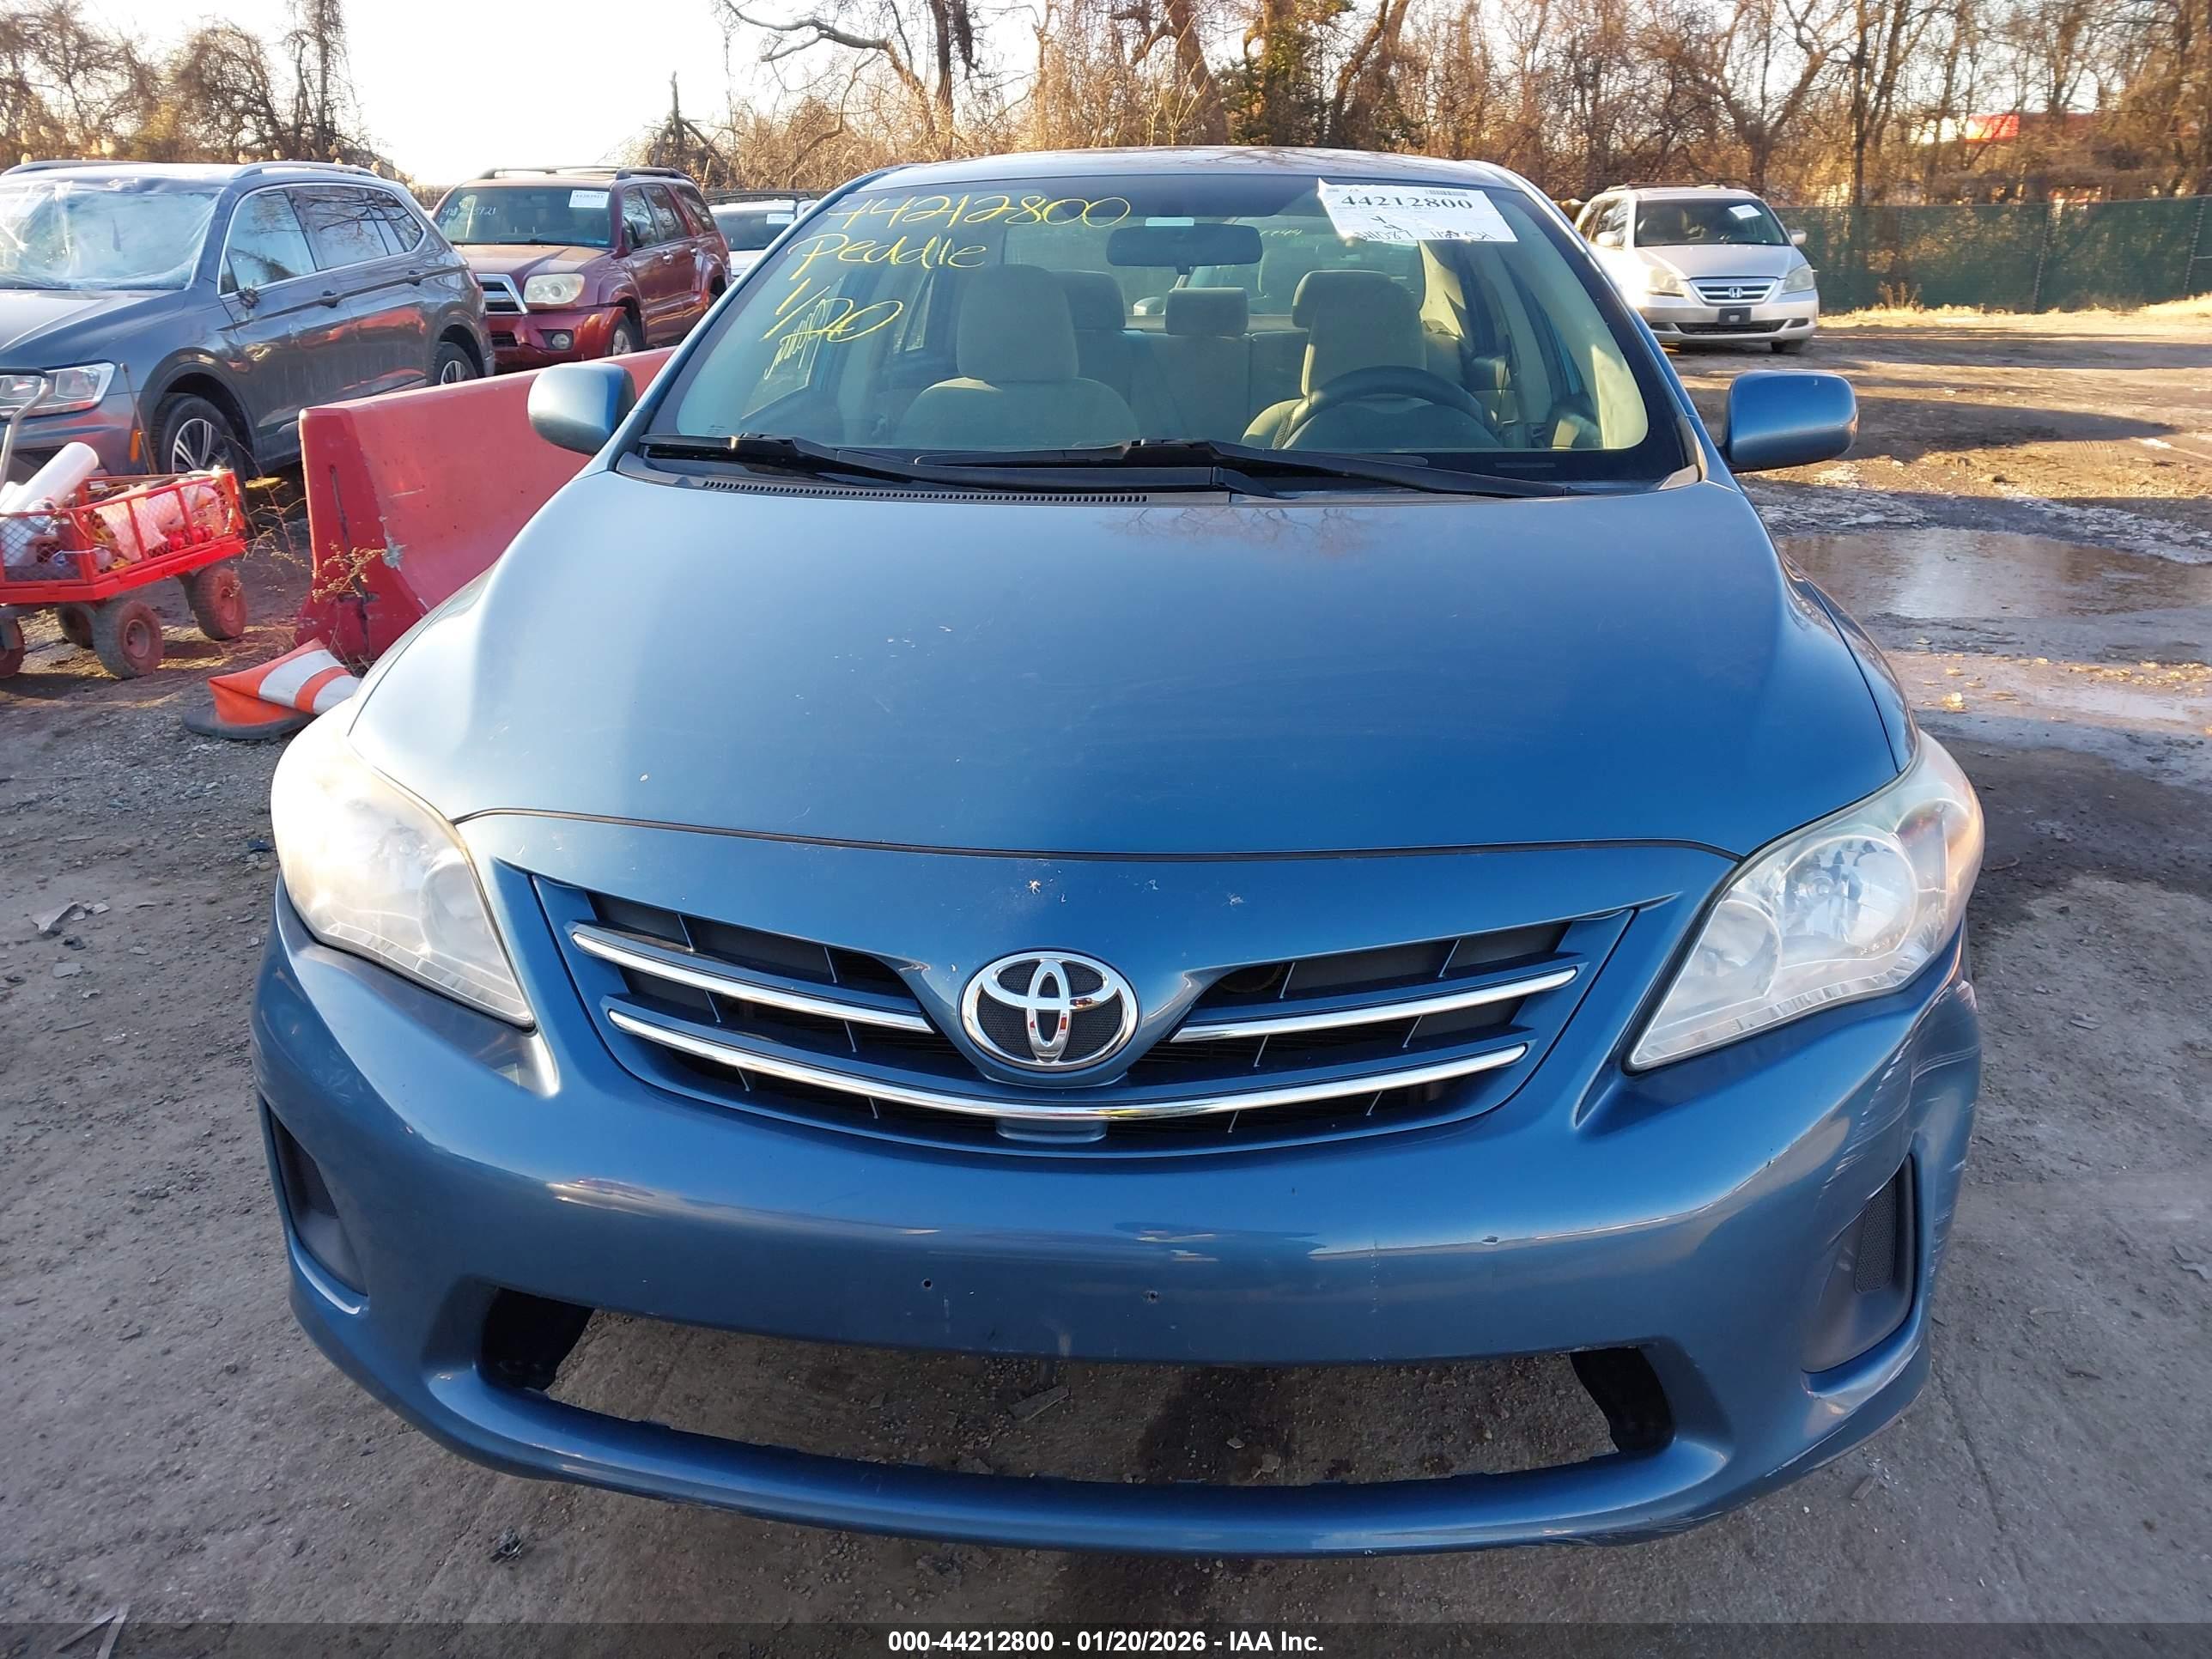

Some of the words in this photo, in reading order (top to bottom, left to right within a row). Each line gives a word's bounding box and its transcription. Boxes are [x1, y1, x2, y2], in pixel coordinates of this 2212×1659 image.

[827, 194, 1131, 231] 44212800
[1340, 195, 1474, 210] 44212800
[787, 233, 987, 281] Peddle
